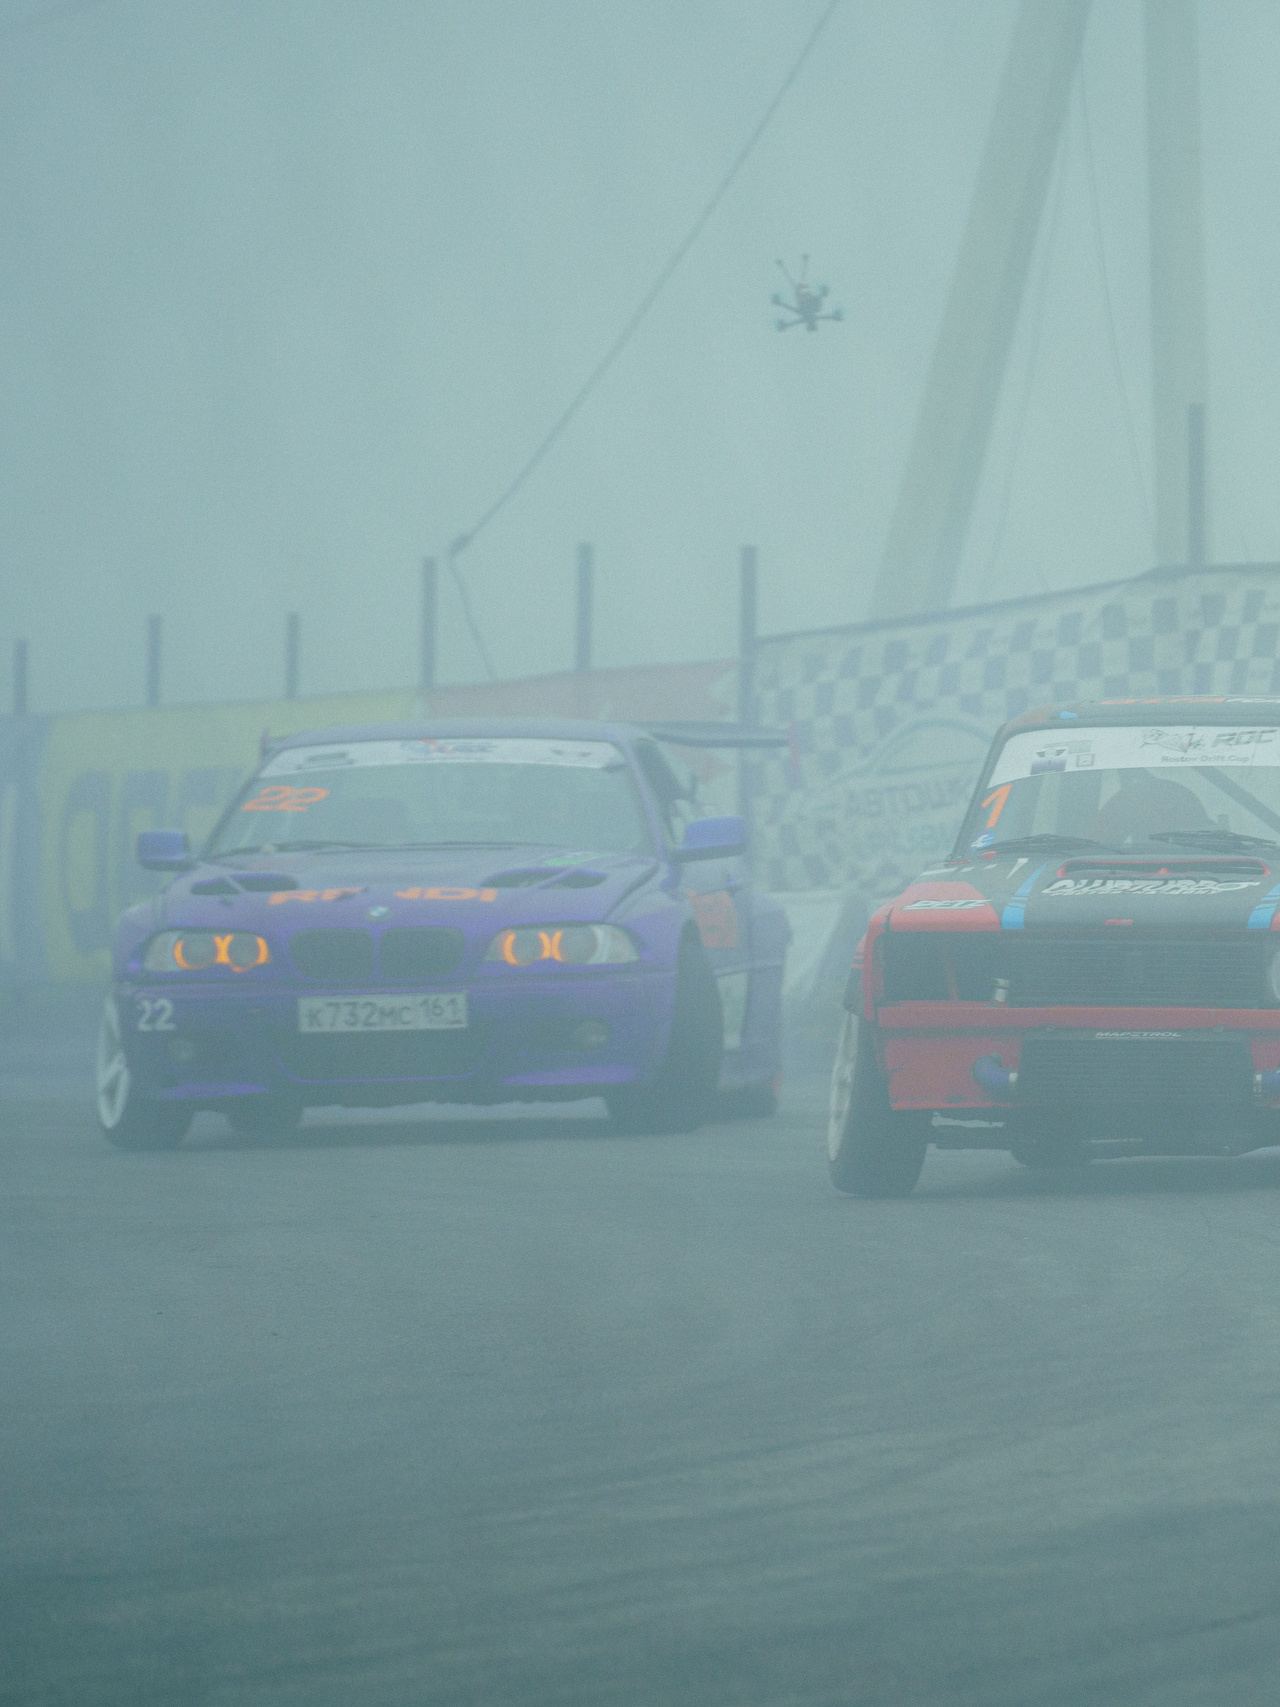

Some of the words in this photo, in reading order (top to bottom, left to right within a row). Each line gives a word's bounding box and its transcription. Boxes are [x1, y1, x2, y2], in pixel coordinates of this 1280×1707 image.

[1228, 754, 1250, 764] Cup
[242, 785, 329, 812] 22
[981, 784, 1013, 829] 1
[137, 998, 176, 1032] 22
